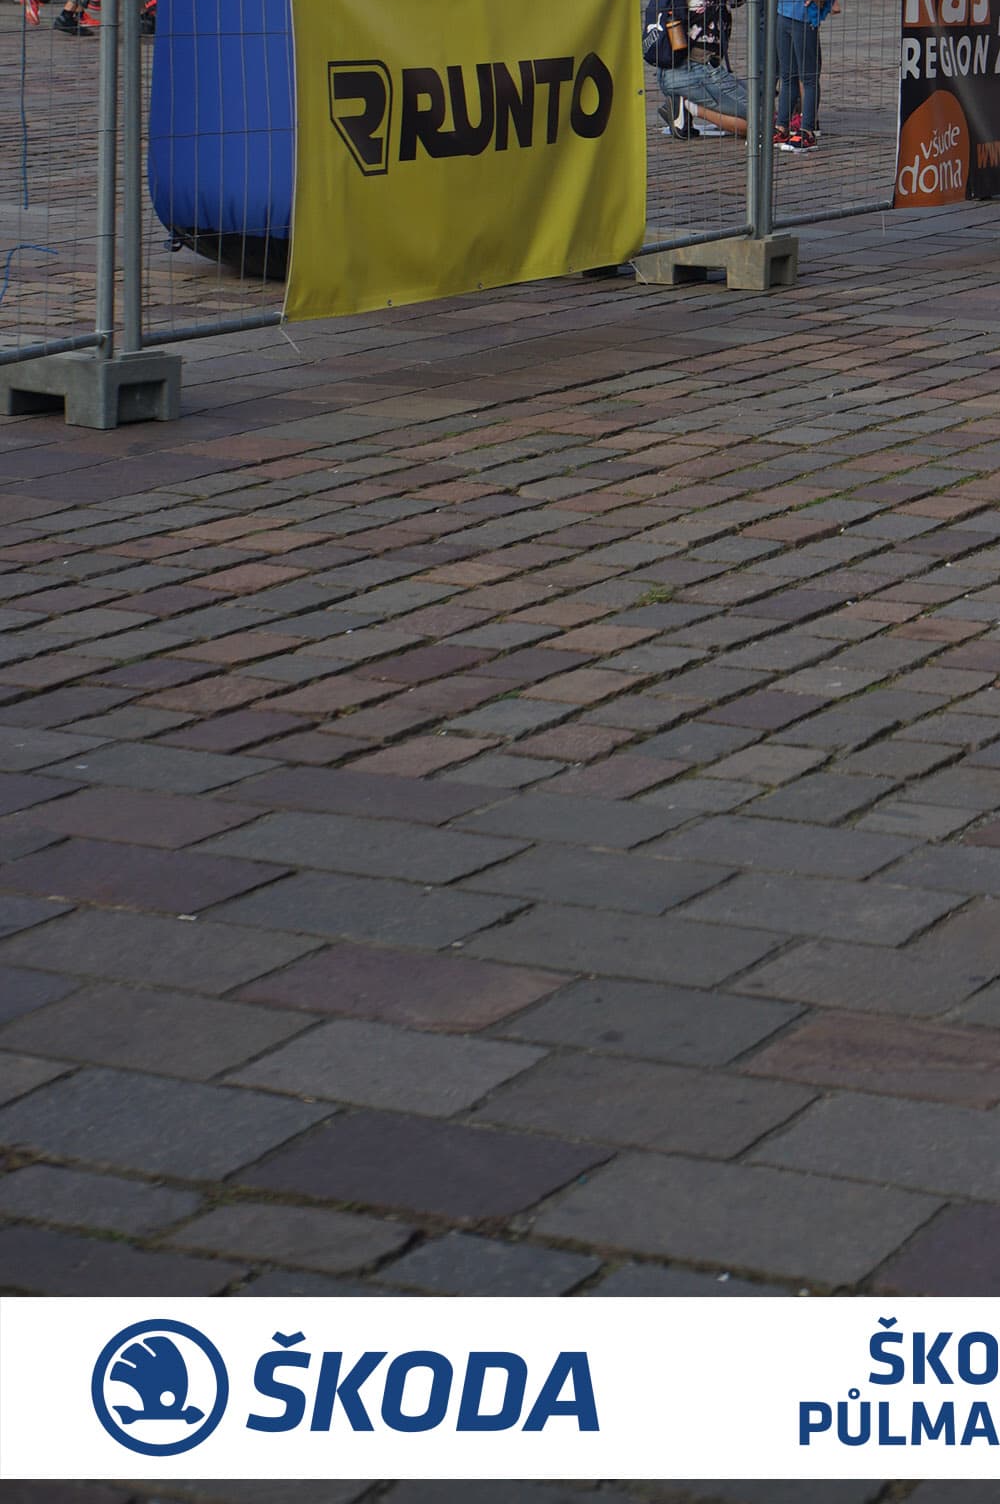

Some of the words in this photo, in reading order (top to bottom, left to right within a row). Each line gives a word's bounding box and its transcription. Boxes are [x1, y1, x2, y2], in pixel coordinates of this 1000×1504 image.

[902, 33, 990, 80] REGION
[399, 52, 614, 162] RUNTO
[920, 122, 960, 160] všude
[899, 156, 963, 196] doma
